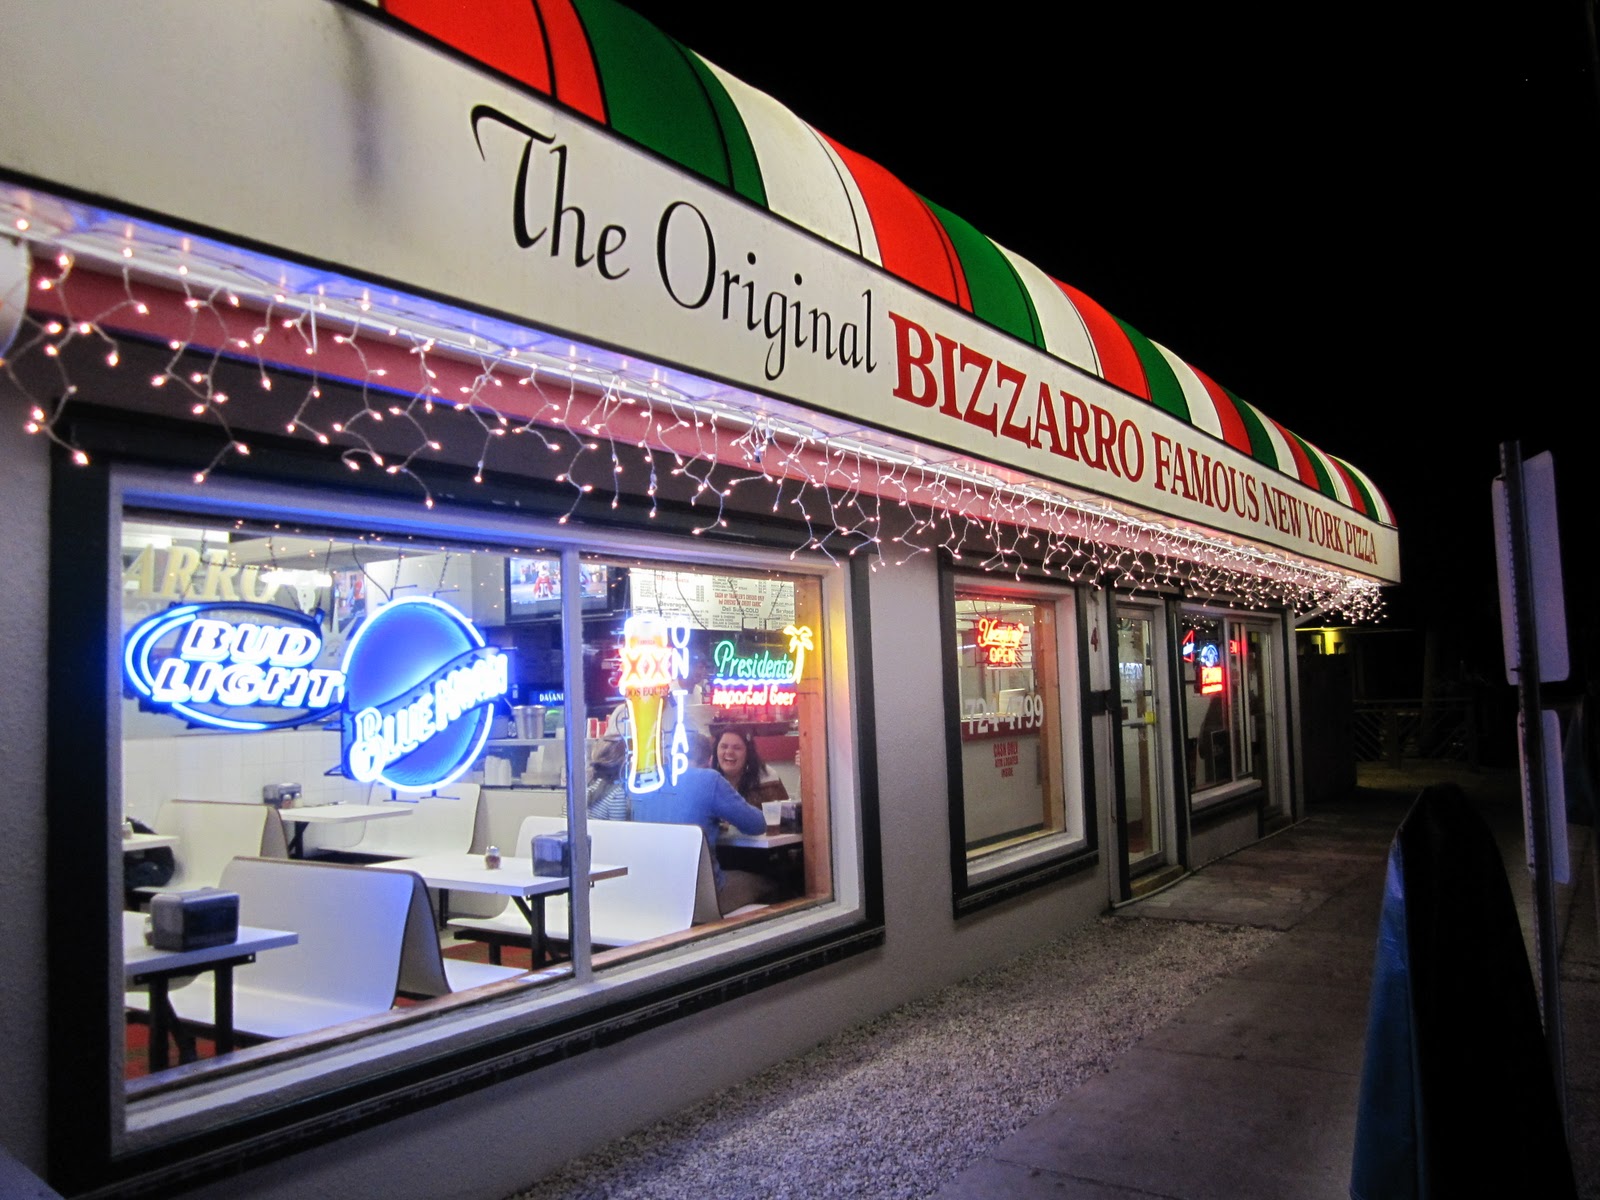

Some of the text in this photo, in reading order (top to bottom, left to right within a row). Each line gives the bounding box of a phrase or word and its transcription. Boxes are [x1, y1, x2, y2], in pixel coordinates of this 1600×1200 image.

[470, 104, 1378, 566] The Original BIZZARRO FAMOUS NEW YORK PIZZA
[152, 618, 346, 708] BUD LIGHT
[714, 640, 795, 679] Presidente
[989, 647, 1016, 664] OPEN
[670, 689, 689, 787] TAP
[965, 694, 1044, 735] 724-4799
